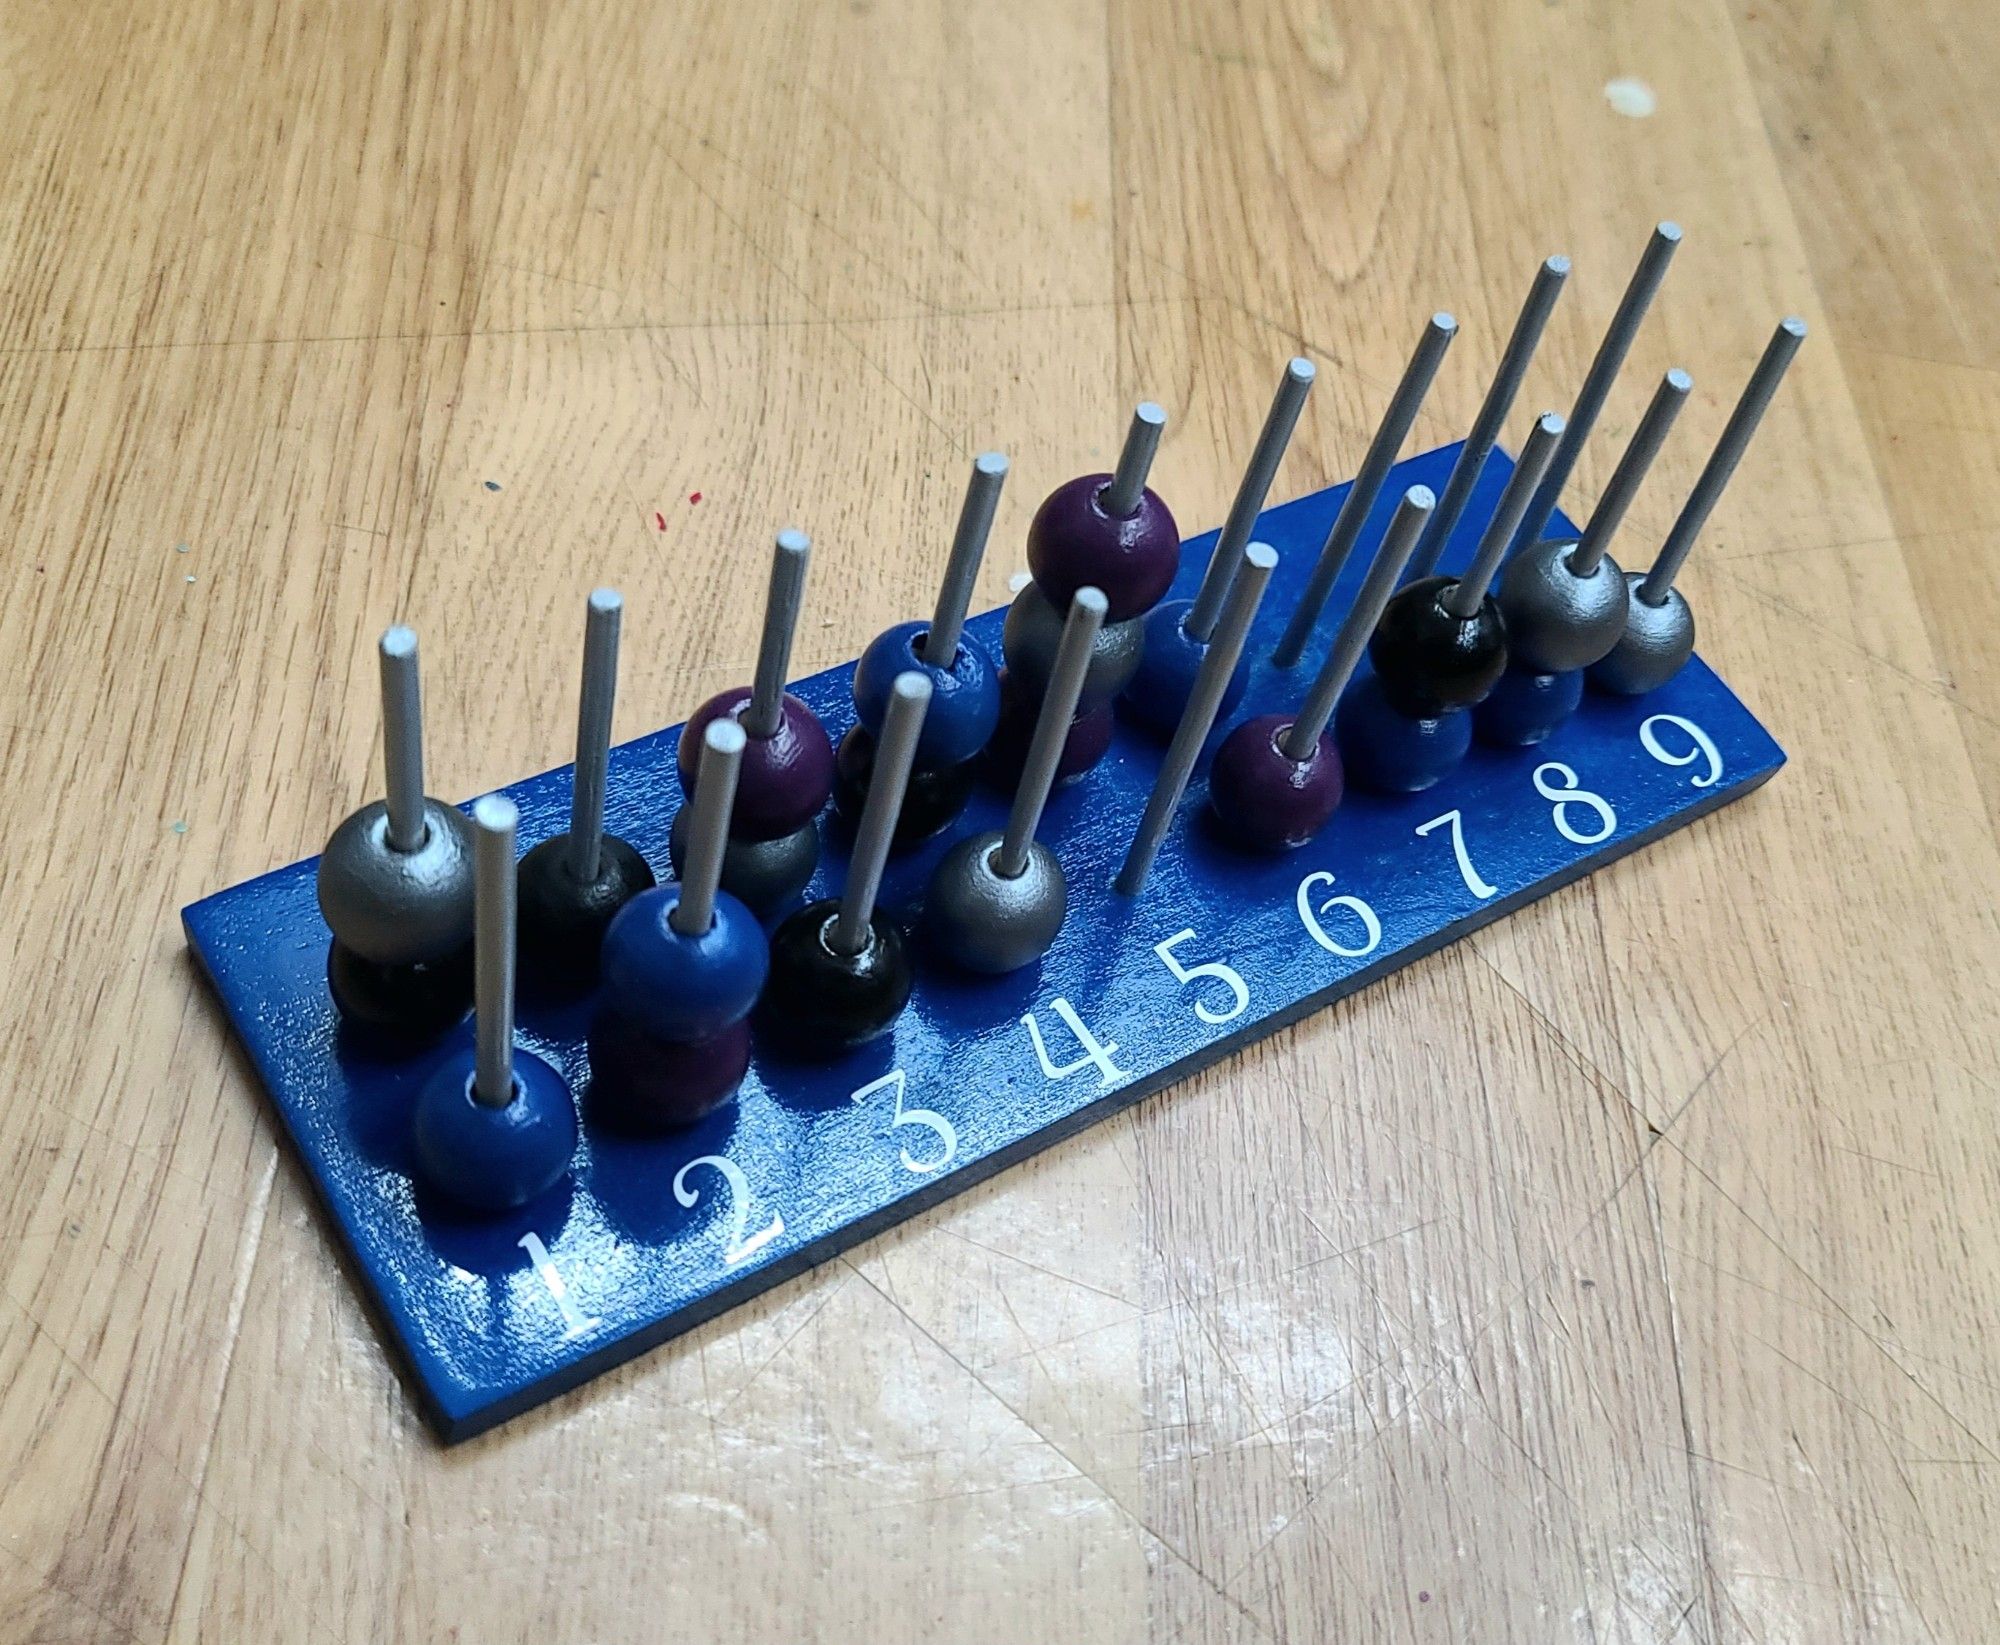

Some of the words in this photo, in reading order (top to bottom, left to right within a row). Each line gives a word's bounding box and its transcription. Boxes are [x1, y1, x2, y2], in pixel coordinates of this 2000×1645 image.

[517, 1231, 601, 1340] 1
[672, 1155, 785, 1265] 2
[850, 1068, 958, 1174] 3
[1019, 997, 1133, 1087] 4
[1152, 927, 1250, 1026] 5
[1296, 871, 1382, 957] 6
[1415, 809, 1499, 899] 7
[1532, 762, 1617, 845] 8
[1639, 714, 1723, 788] 9
